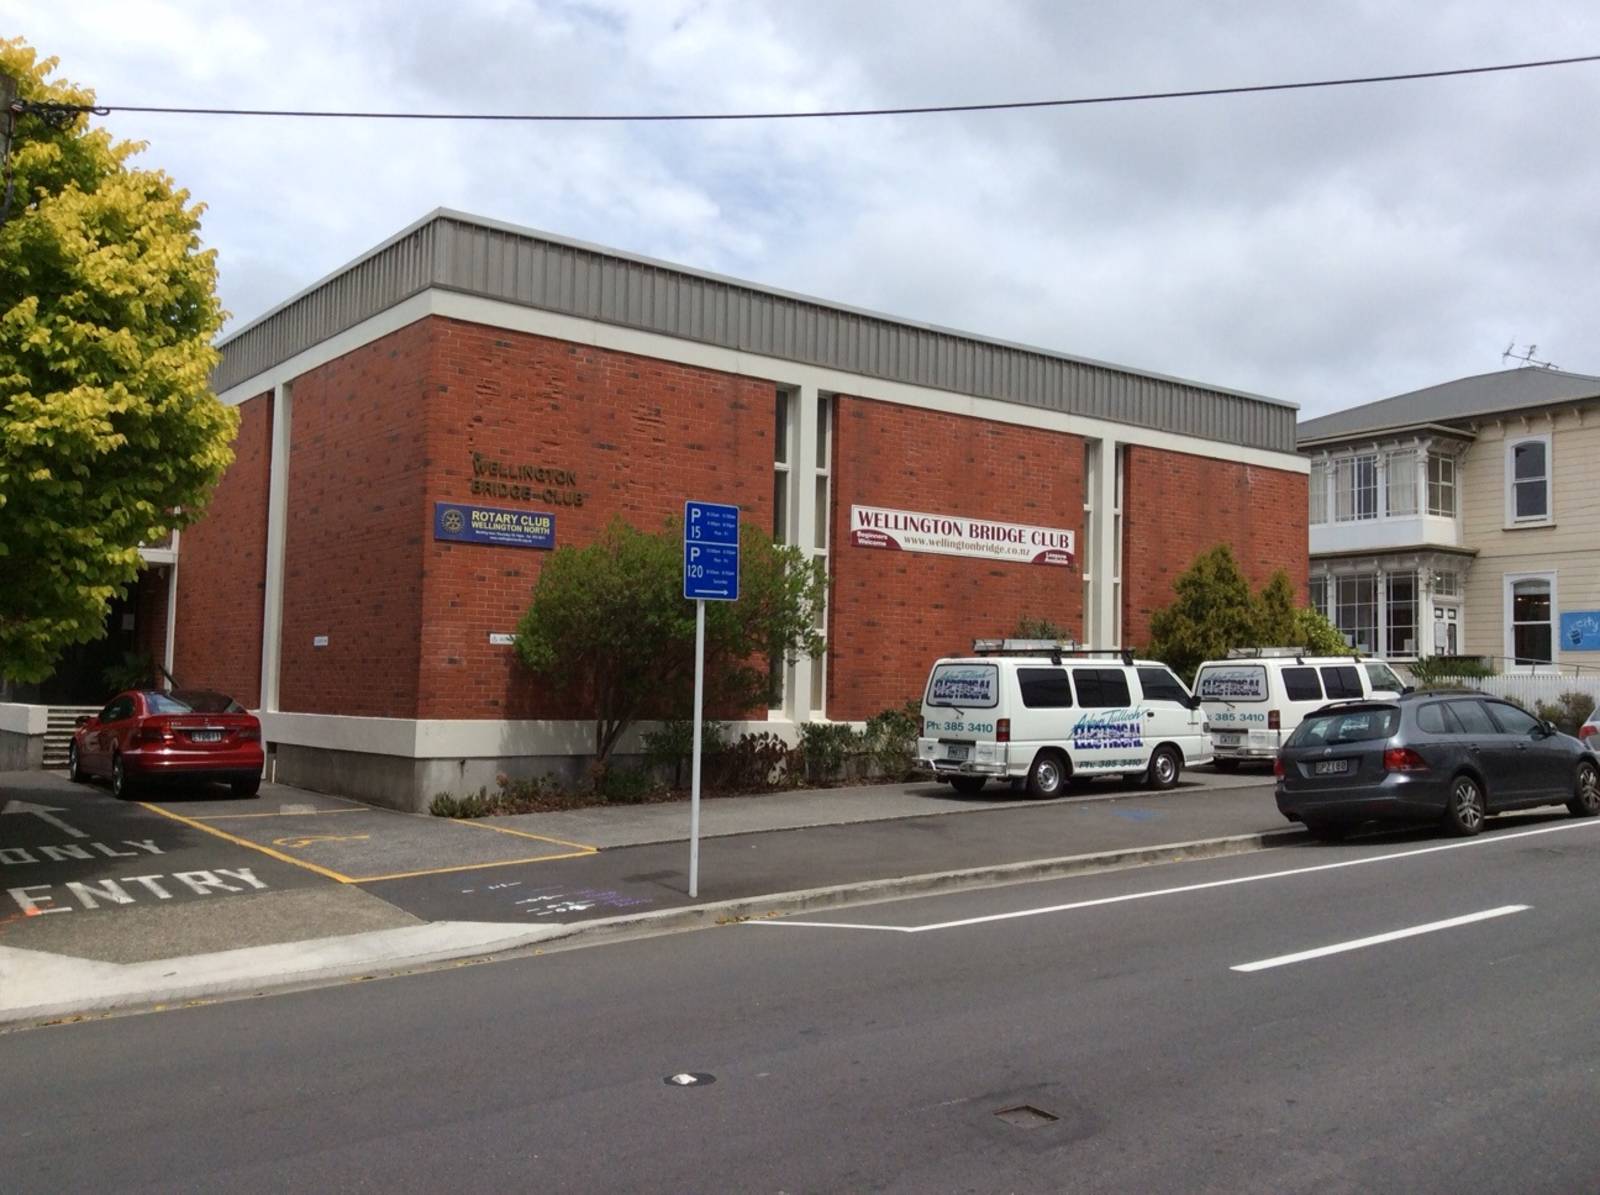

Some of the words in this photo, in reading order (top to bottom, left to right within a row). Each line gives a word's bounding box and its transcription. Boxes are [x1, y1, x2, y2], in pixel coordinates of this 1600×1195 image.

[473, 456, 577, 486] WELLINGTON
[471, 479, 532, 501] BRIDGE
[543, 488, 583, 507] CLUB
[471, 510, 518, 525] ROTARY
[520, 515, 550, 528] CLUB
[691, 508, 701, 523] P
[471, 521, 522, 532] WELLINGTON
[523, 525, 550, 535] NORTH
[691, 526, 701, 539] 15
[858, 510, 963, 537] WELLINGTON
[969, 523, 1026, 544] BRIDGE
[1031, 530, 1069, 549] CLUB
[903, 535, 1031, 556] www.wellingtonbridge.co.nz
[690, 547, 701, 562] P
[688, 565, 703, 578] 120
[1215, 712, 1236, 722] 385
[1239, 713, 1265, 722] 3410
[944, 722, 964, 732] 385
[967, 723, 993, 733] 3410
[1099, 759, 1118, 768] 385
[1120, 758, 1143, 767] 3410
[0, 839, 167, 865] ONLY
[6, 868, 269, 917] ENTRY
